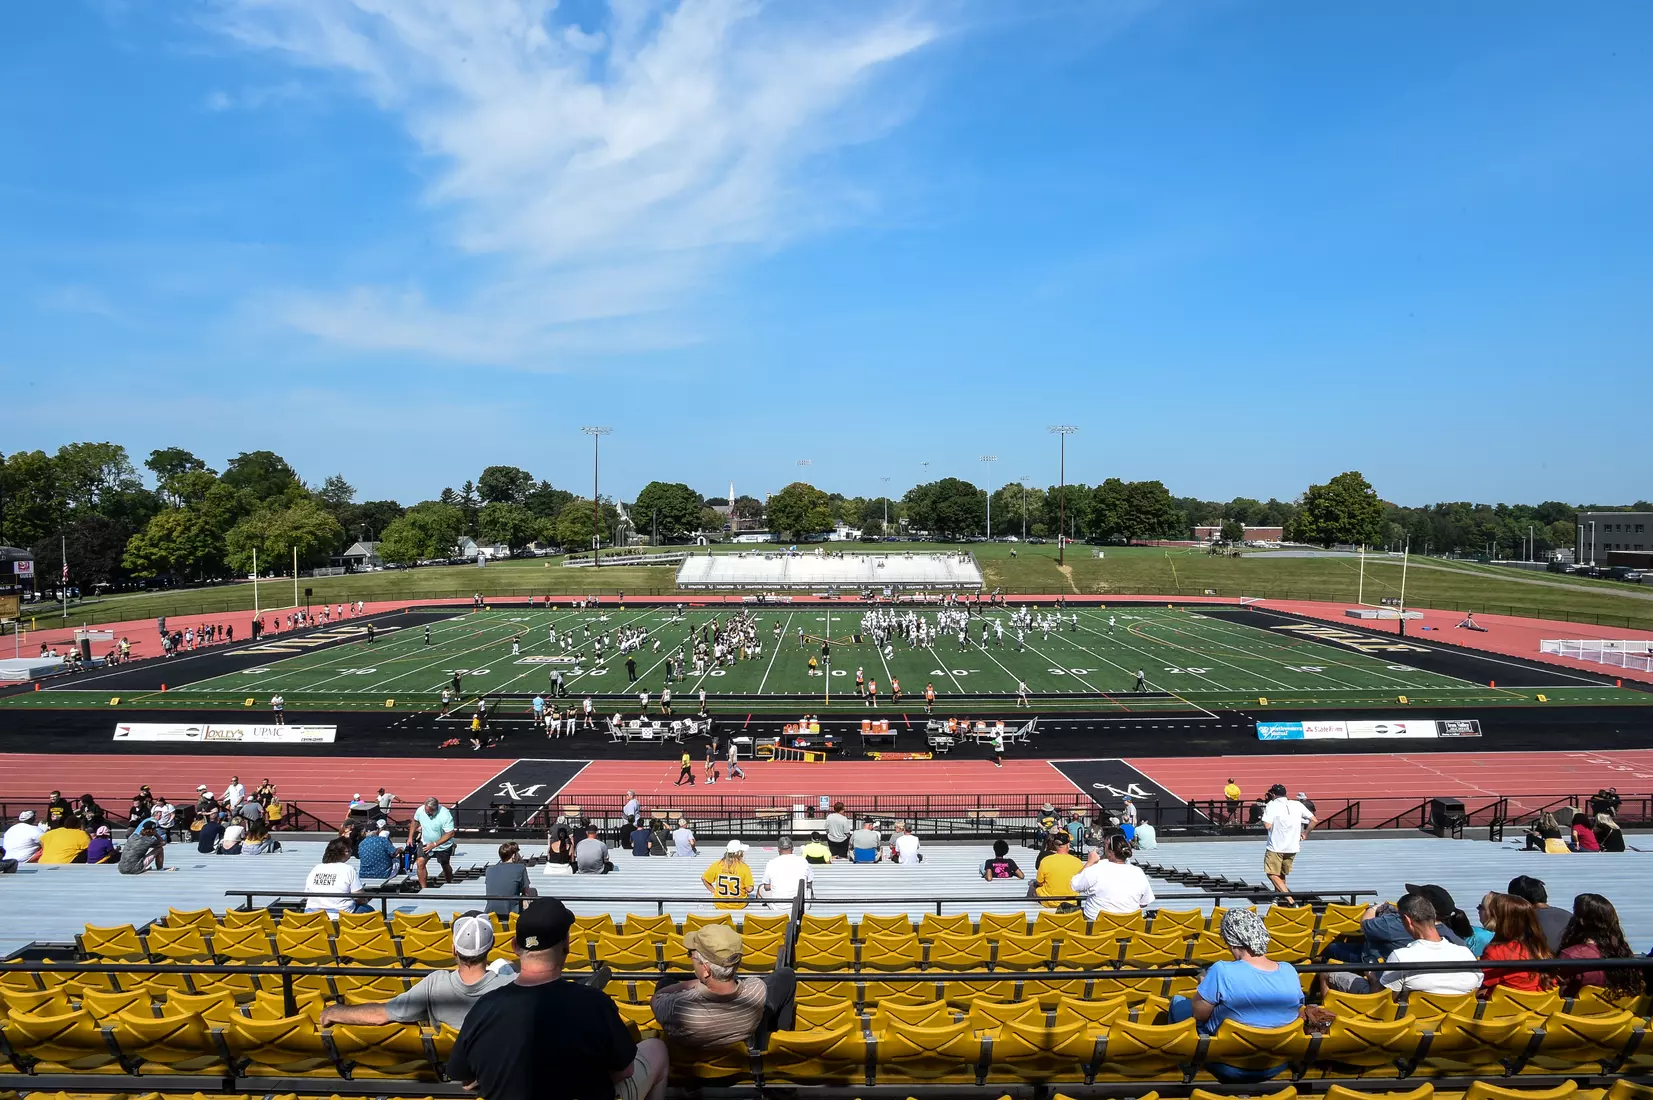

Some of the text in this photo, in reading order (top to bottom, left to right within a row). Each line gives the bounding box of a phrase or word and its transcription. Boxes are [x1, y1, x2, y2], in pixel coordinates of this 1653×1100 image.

[253, 727, 284, 737] UPMC
[312, 878, 336, 886] PARENT
[717, 875, 741, 897] 53
